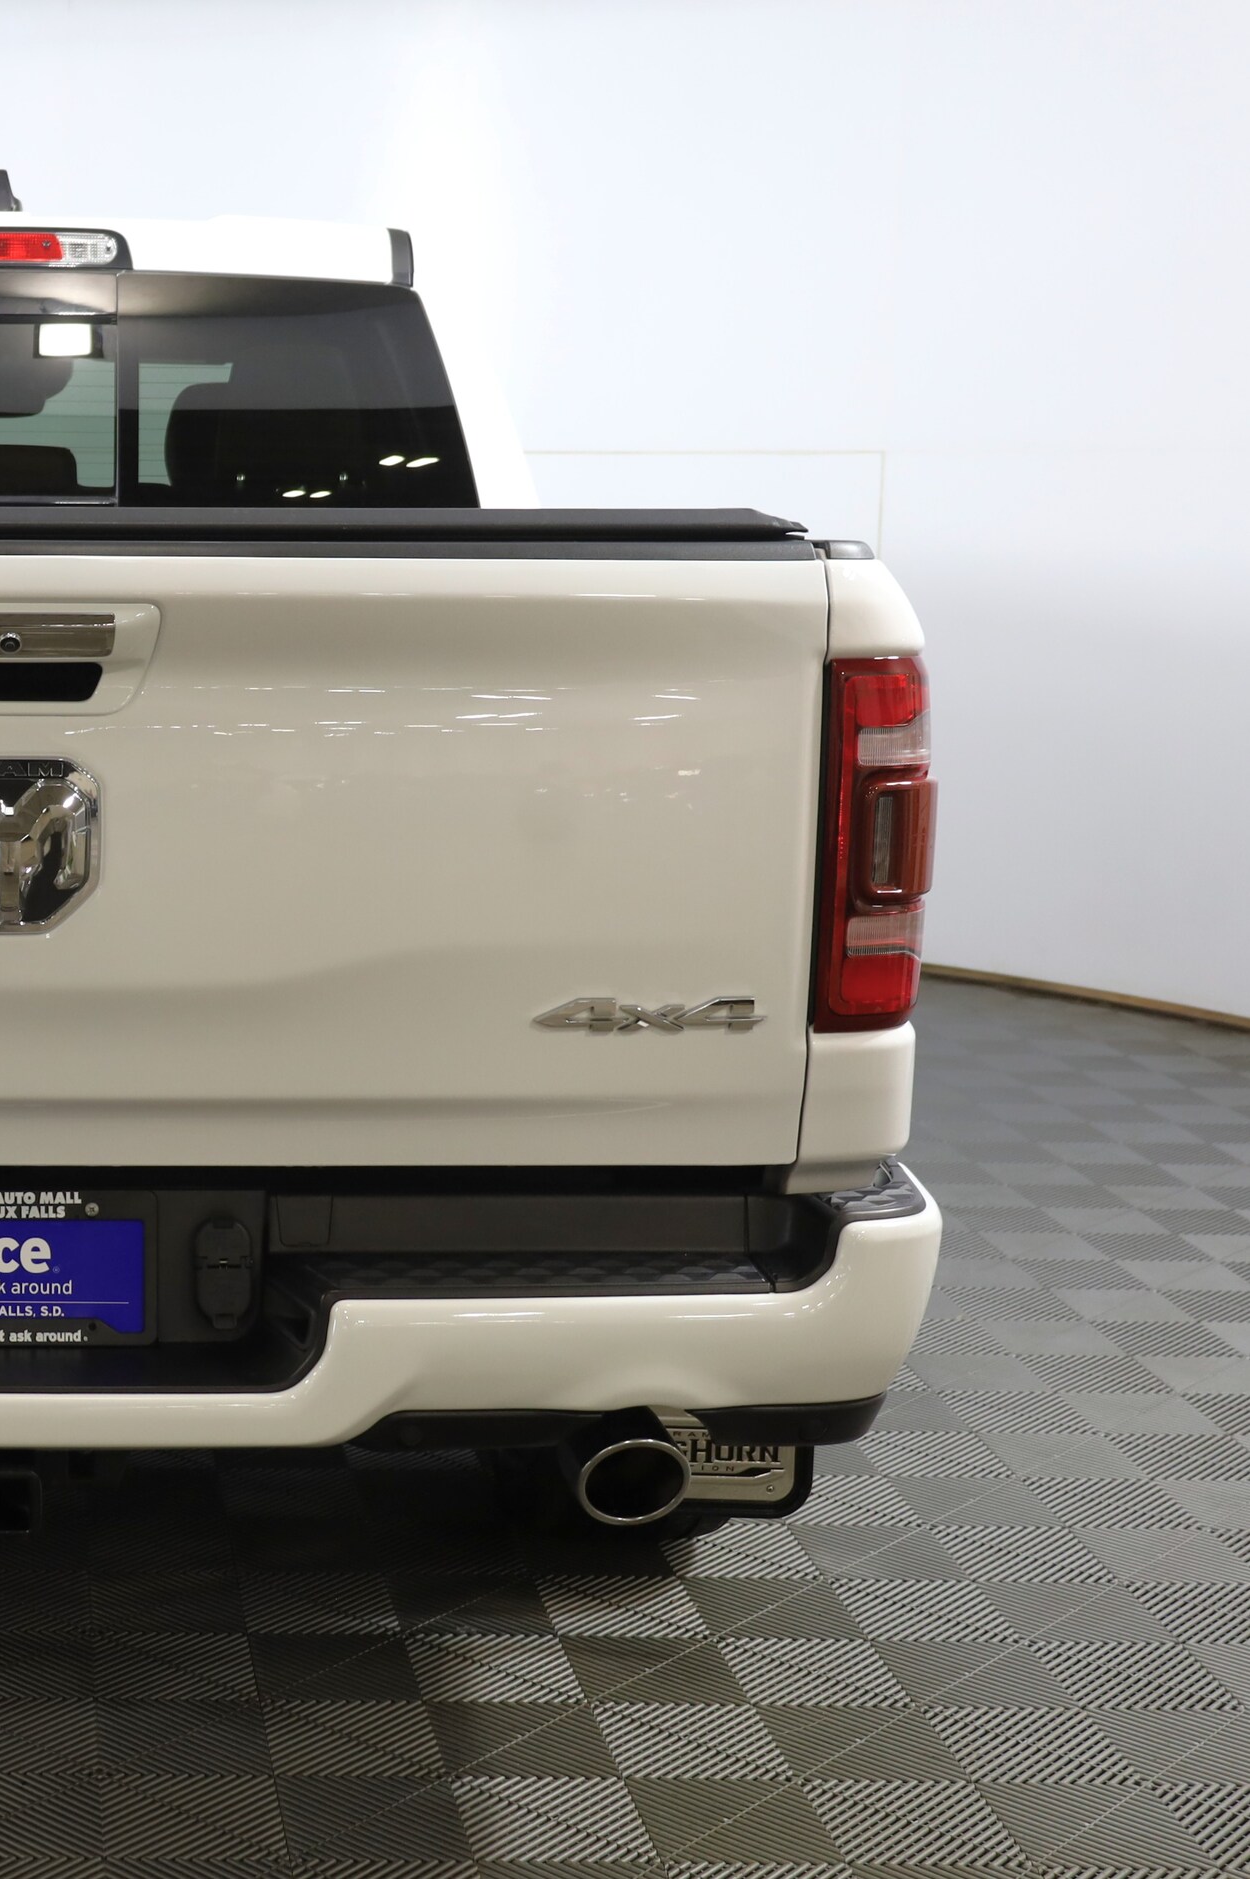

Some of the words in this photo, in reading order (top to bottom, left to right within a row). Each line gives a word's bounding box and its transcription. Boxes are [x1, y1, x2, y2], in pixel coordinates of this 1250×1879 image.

[39, 1191, 82, 1205] MALL
[21, 1206, 66, 1219] FALLS
[11, 1280, 73, 1295] around
[40, 1305, 65, 1317] S.D.
[9, 1329, 32, 1342] ask
[673, 1430, 710, 1438] RAM
